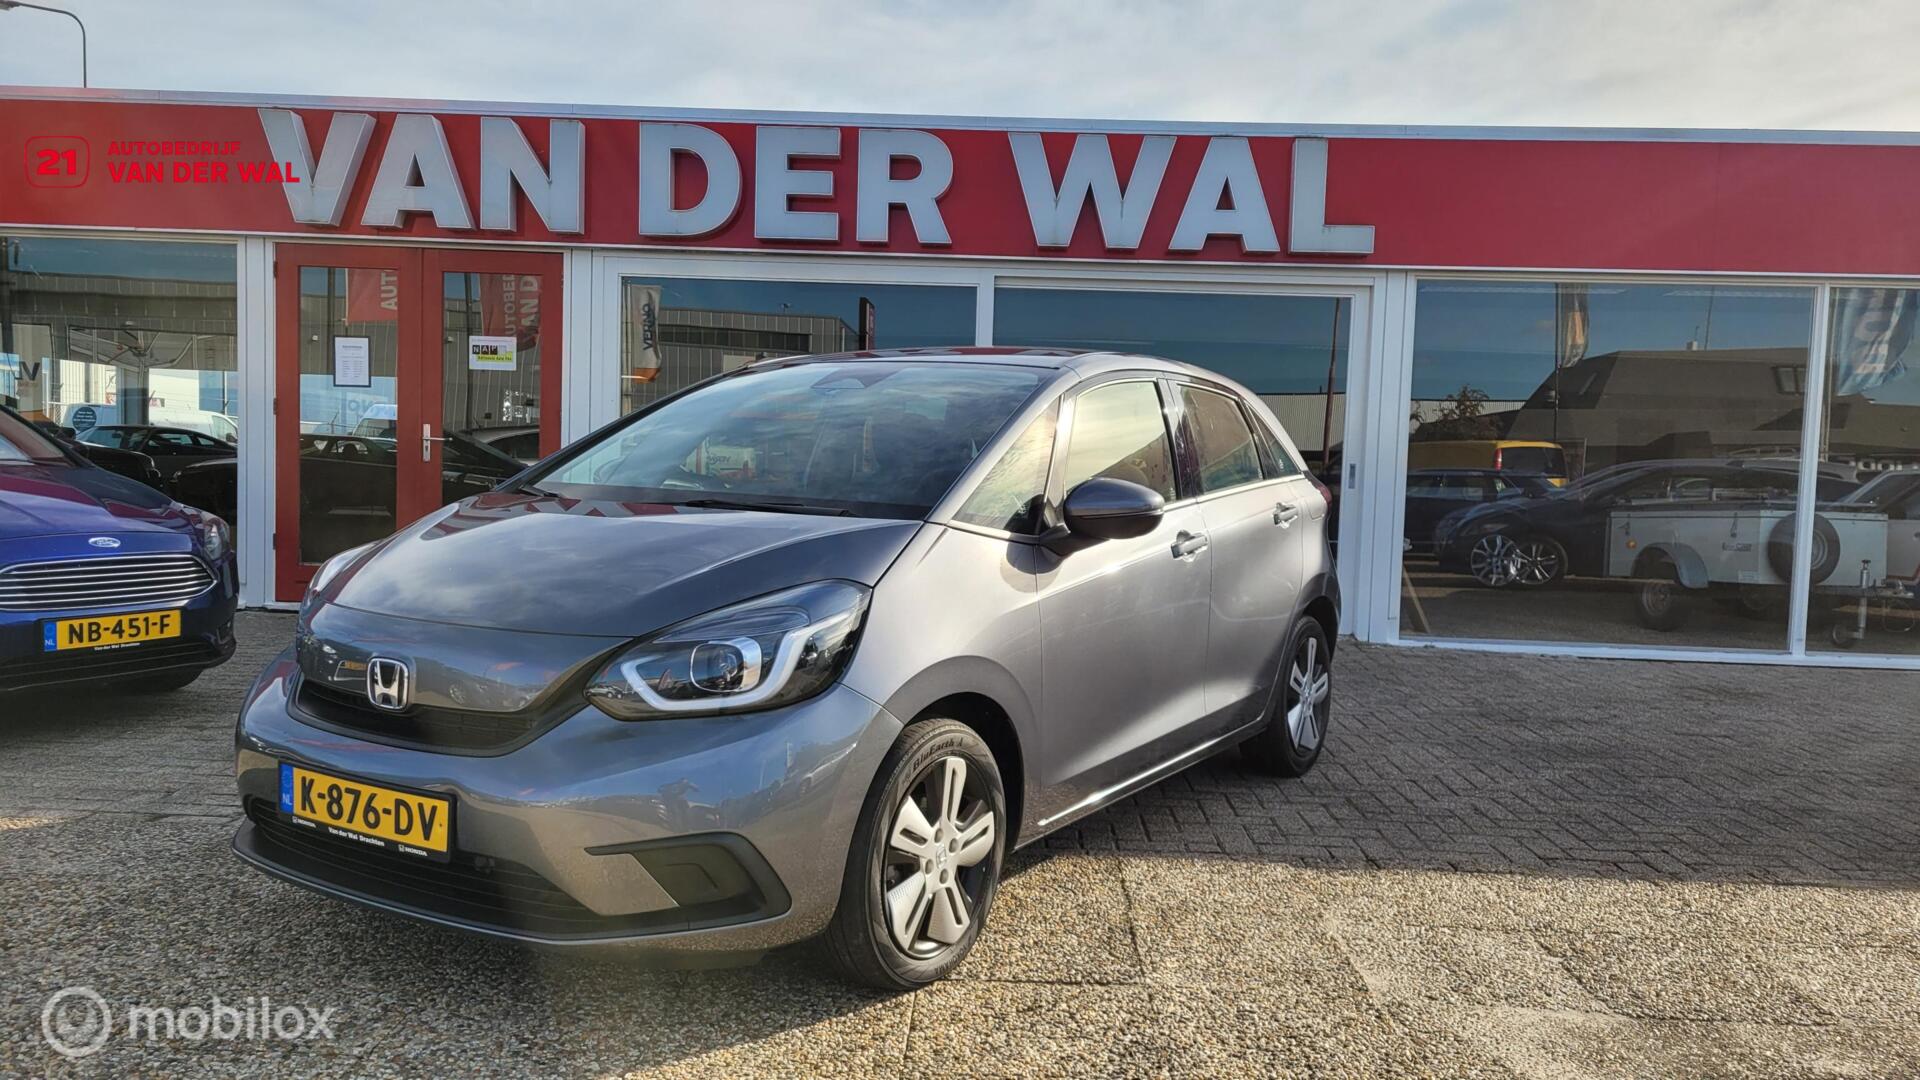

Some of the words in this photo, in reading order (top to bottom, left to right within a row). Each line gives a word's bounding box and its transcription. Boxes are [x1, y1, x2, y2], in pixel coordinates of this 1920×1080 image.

[257, 107, 586, 234] VAN
[638, 121, 954, 247] DER
[1007, 131, 1376, 255] WAL
[380, 269, 398, 310] AUT
[68, 614, 171, 644] NB-451-F
[282, 793, 292, 806] NL
[301, 776, 438, 841] K-876-DV
